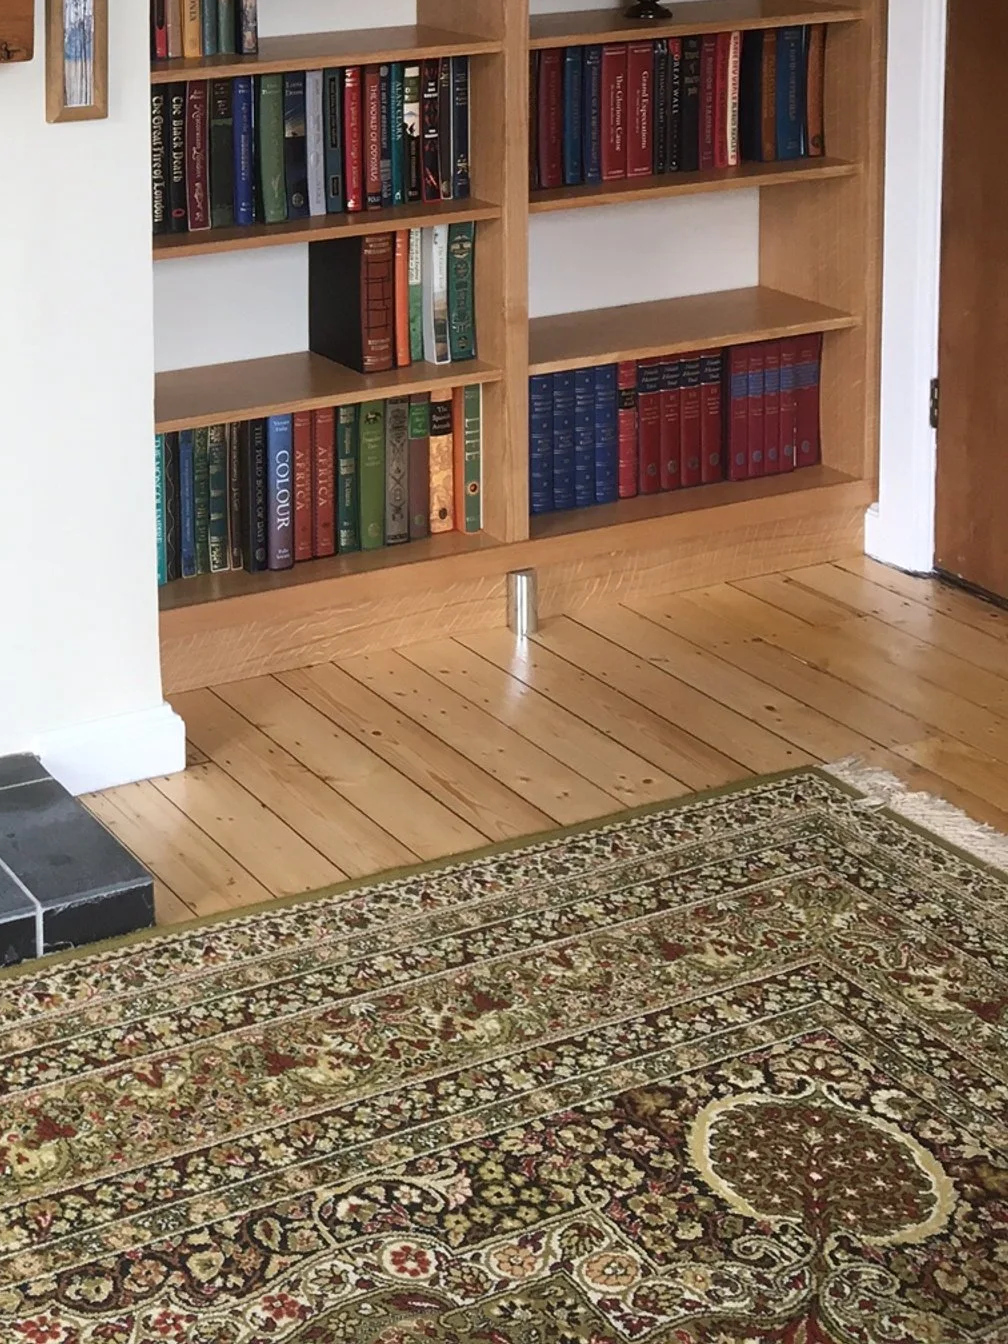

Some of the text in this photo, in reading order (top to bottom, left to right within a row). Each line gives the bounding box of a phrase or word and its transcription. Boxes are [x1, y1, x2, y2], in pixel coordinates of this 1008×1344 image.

[672, 54, 680, 85] GREAT
[152, 114, 165, 147] Great
[153, 95, 164, 114] The
[370, 84, 379, 182] THE WORLD OF ODYSSEUS
[615, 91, 623, 125] Glorious
[640, 71, 649, 149] Grand Expectations
[172, 96, 184, 183] The Black Death
[153, 181, 166, 222] London
[465, 418, 480, 462] LIFE
[255, 426, 266, 542] THE FOLIO BOOK OF DAYS
[276, 450, 290, 530] COLOUR
[296, 451, 305, 510] AFRICA
[318, 447, 328, 506] AFRICA
